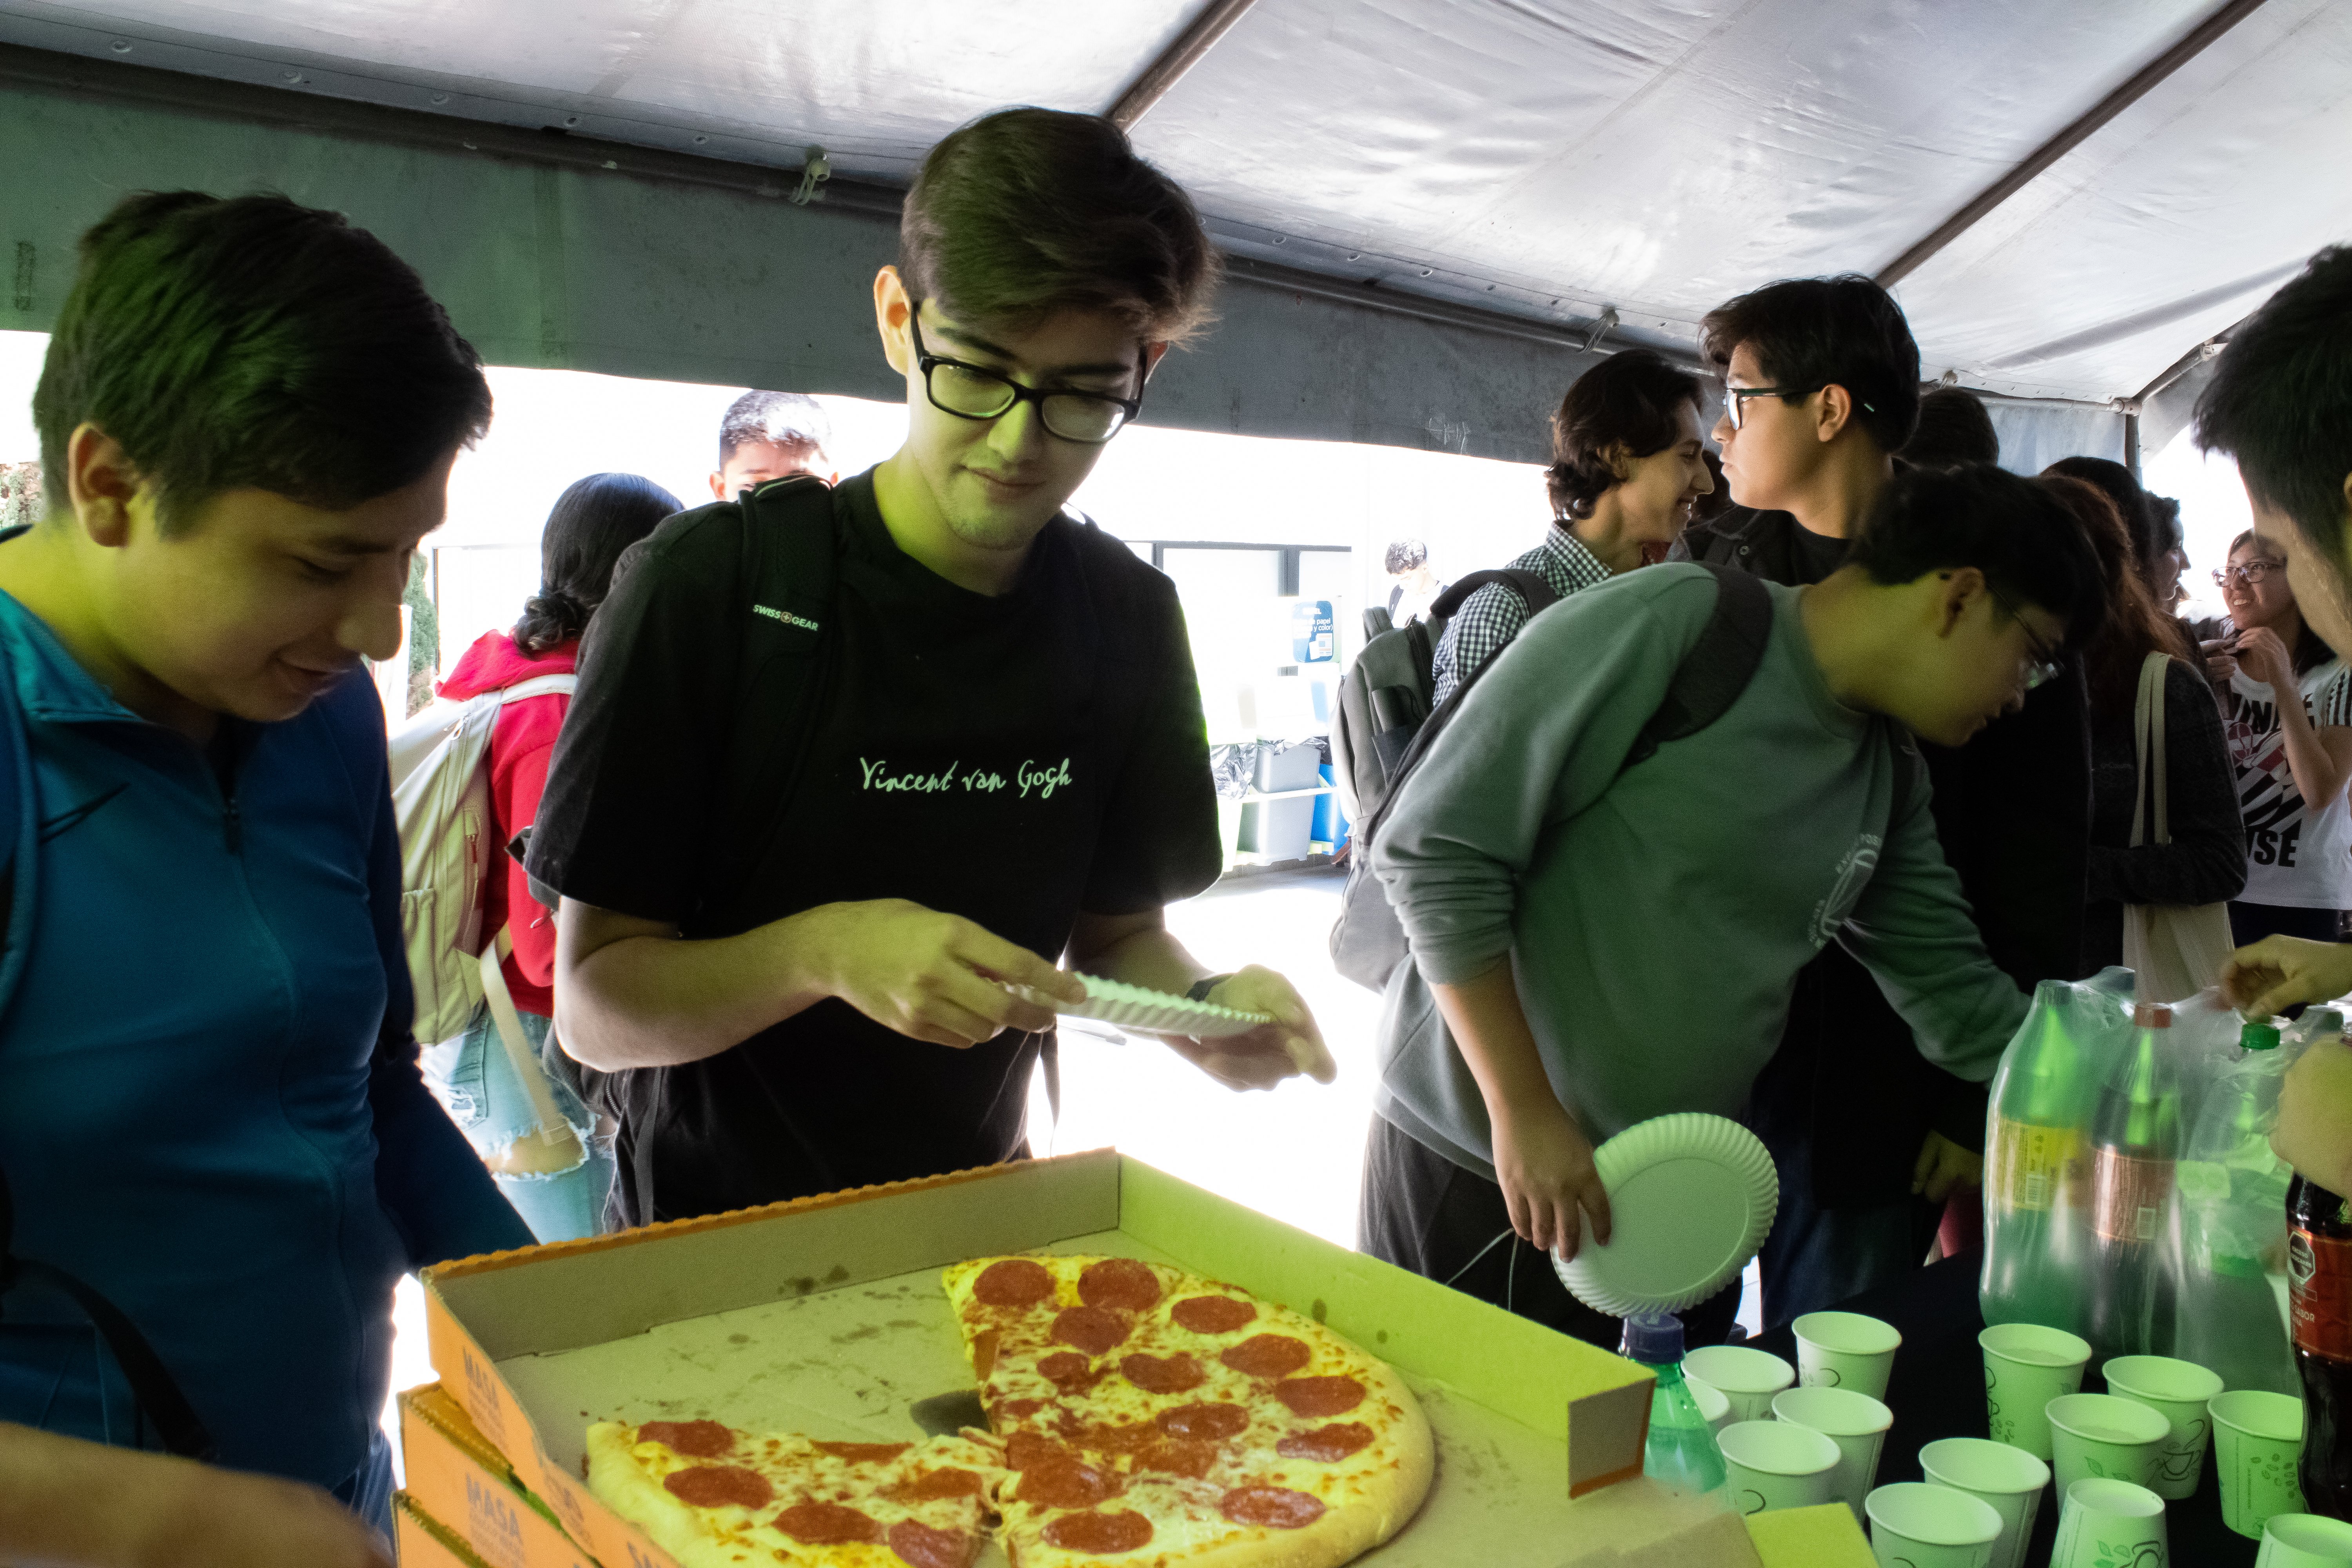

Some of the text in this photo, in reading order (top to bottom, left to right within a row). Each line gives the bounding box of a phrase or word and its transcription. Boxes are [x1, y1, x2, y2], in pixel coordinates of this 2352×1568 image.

[753, 604, 818, 631] SWISS GEAR
[860, 757, 1073, 799] Vincent van Gogh
